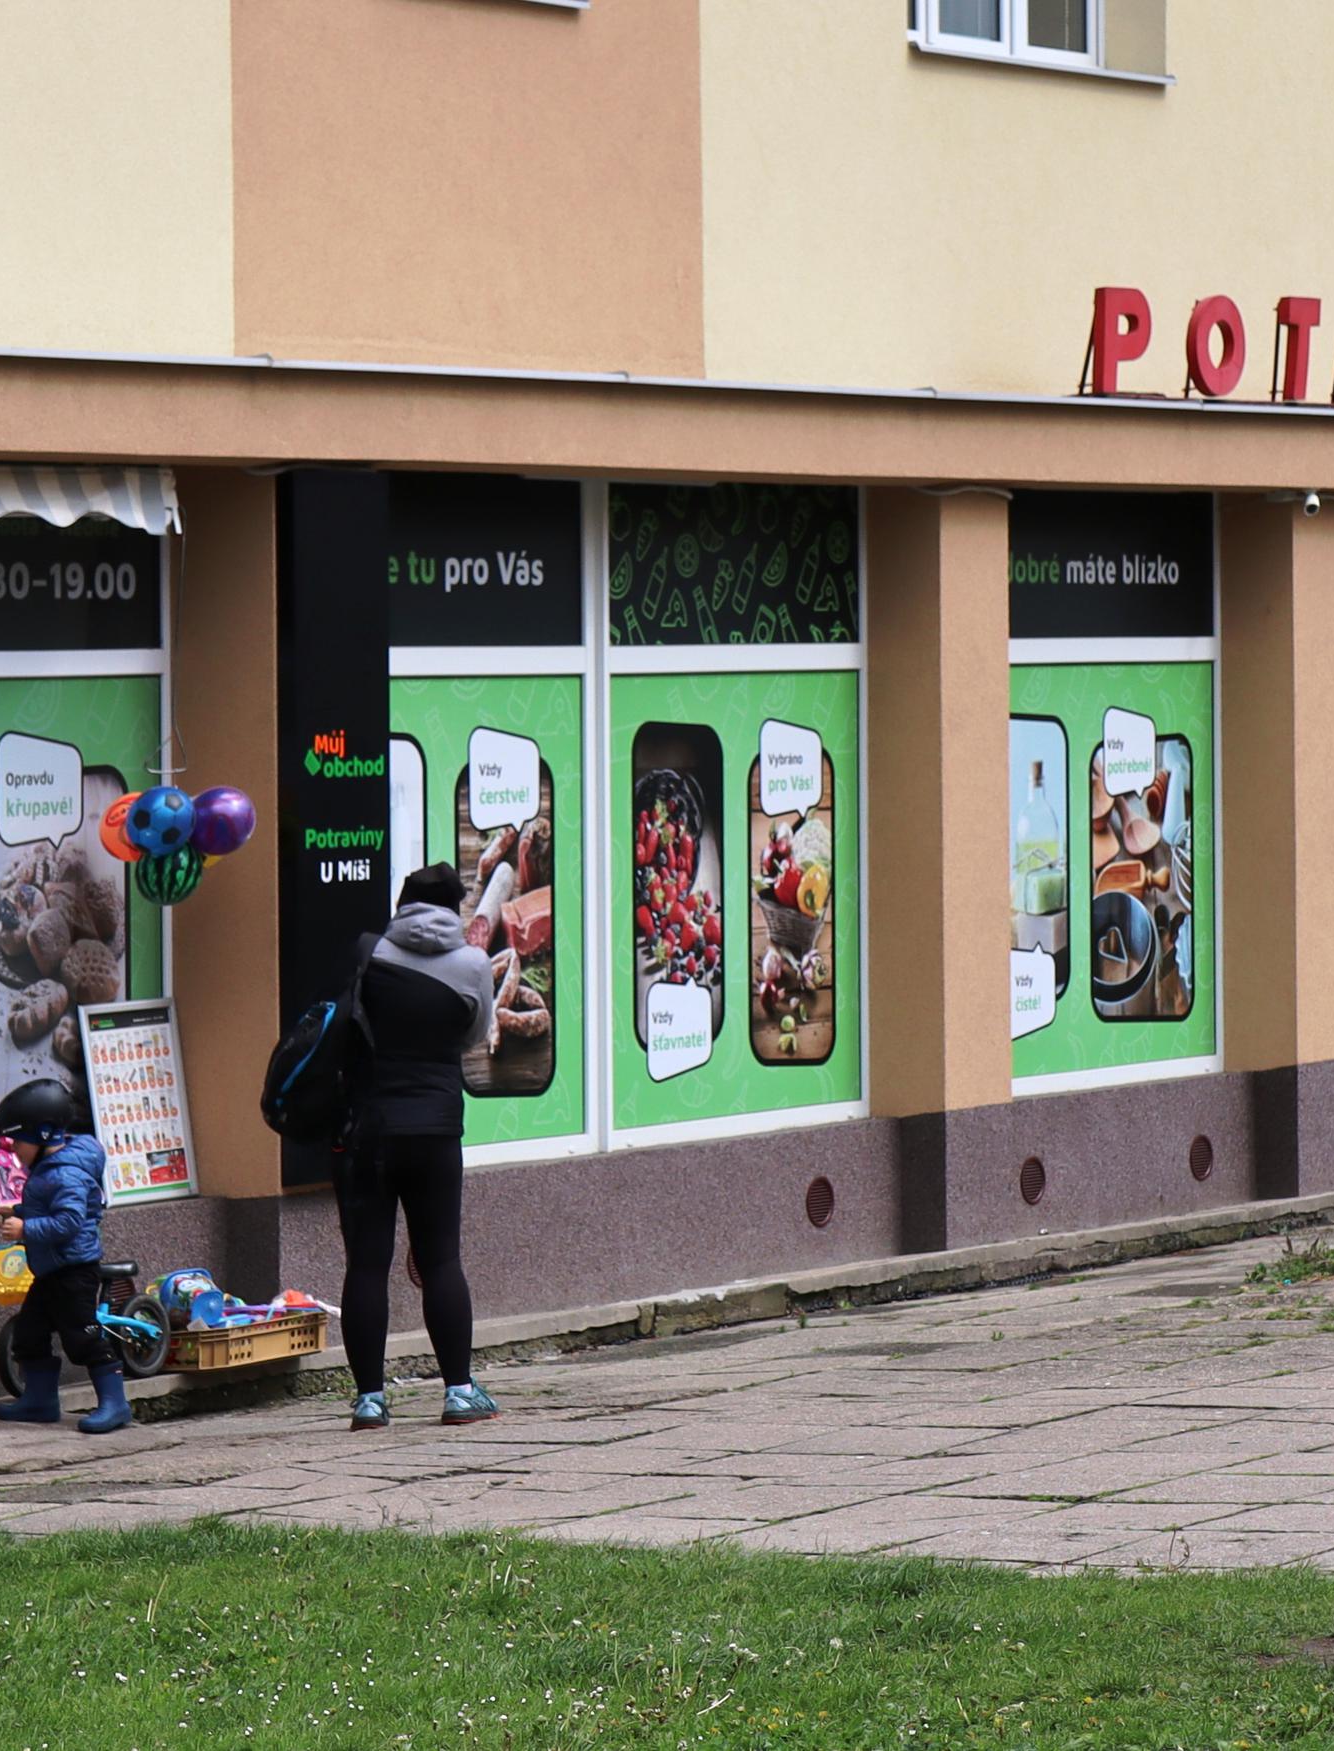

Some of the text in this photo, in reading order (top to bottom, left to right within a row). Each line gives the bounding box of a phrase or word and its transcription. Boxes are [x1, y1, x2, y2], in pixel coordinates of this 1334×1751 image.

[408, 551, 435, 584] tu
[445, 557, 489, 593] pro
[497, 550, 544, 586] Vás
[1067, 553, 1116, 584] máte
[1123, 554, 1179, 584] blízko
[314, 730, 345, 758] Můj
[323, 755, 385, 778] obchod
[478, 763, 502, 779] Vždy
[768, 753, 803, 768] Vybráno
[5, 771, 54, 787] Opravdu
[768, 775, 814, 795] pro Vás!
[479, 786, 530, 805] čerstvé!
[6, 797, 73, 820] křupavé!
[305, 825, 384, 851] Potraviny
[320, 862, 333, 883] U
[652, 1030, 707, 1052] šťavnaté!
